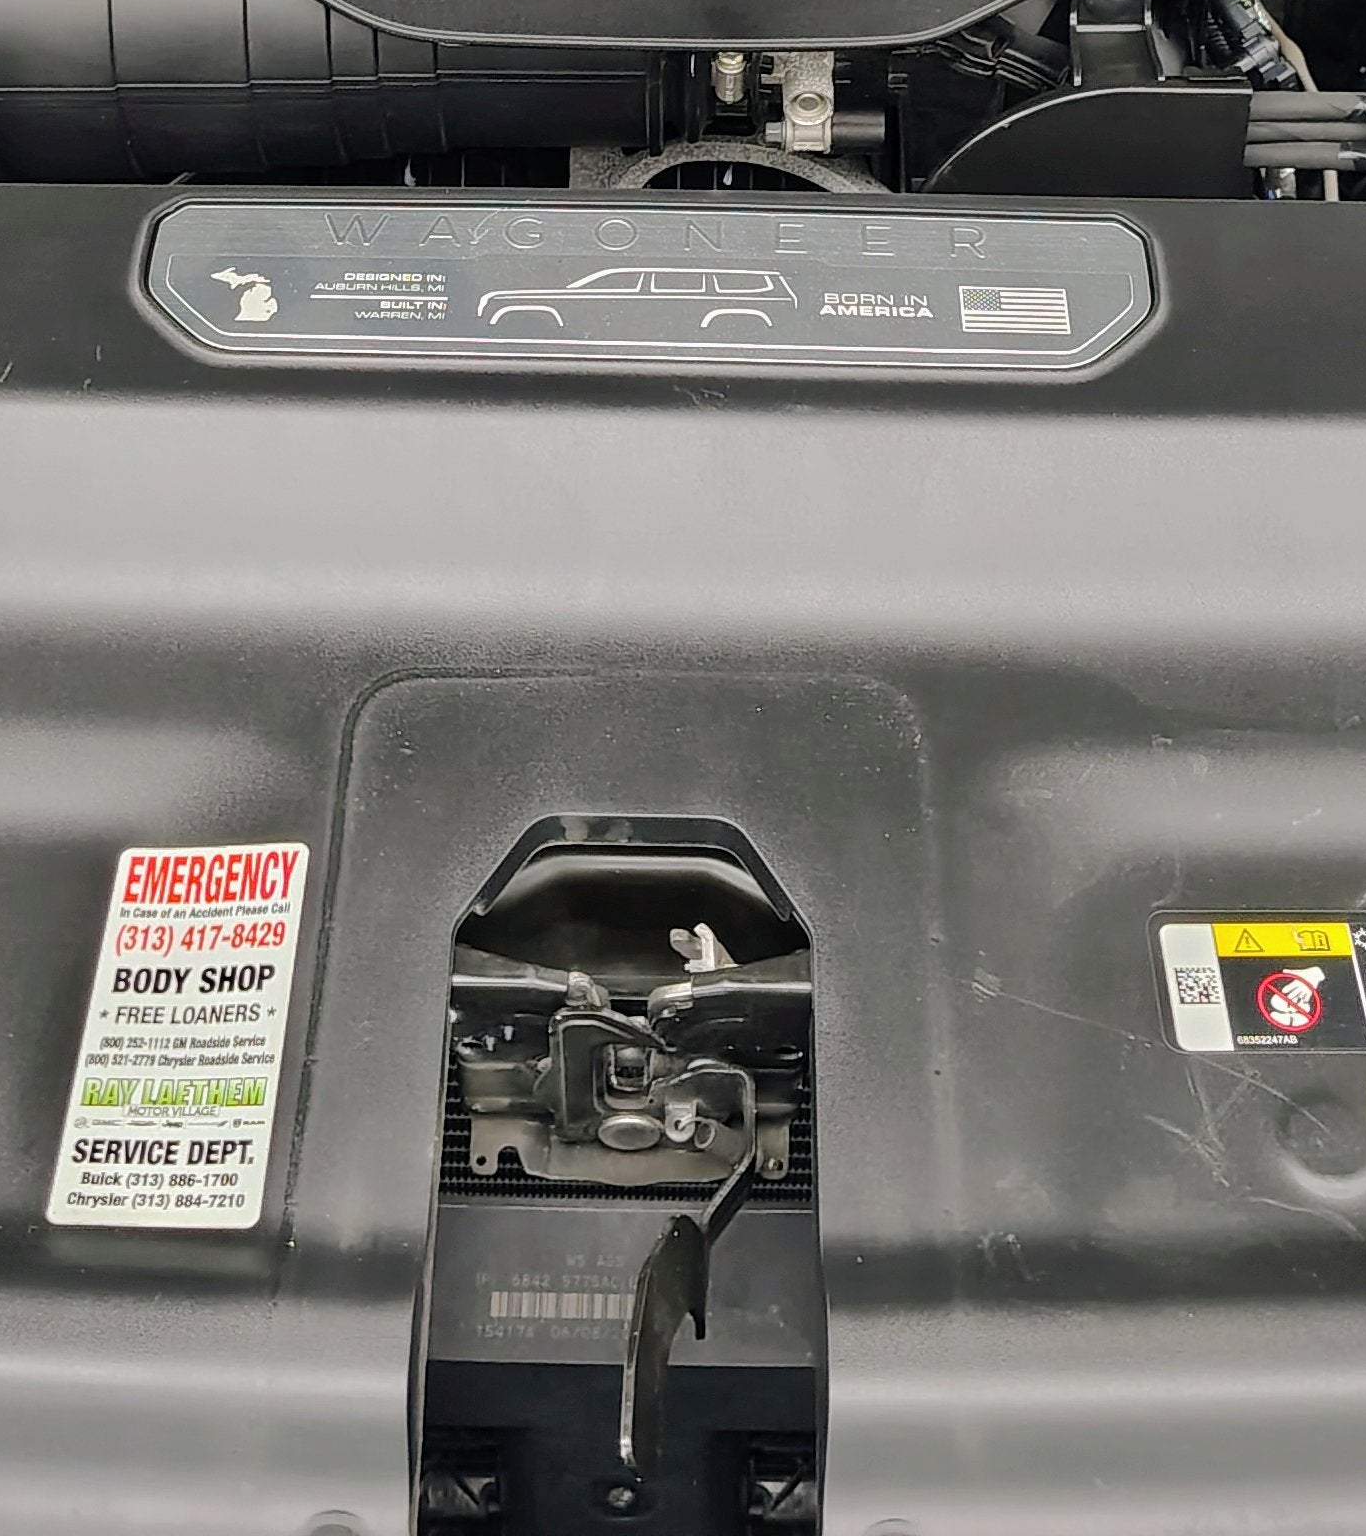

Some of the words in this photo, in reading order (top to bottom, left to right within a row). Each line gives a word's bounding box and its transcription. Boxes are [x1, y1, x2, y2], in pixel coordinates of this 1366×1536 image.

[323, 212, 987, 259] WAGONEER
[343, 272, 423, 282] DESIGNED
[314, 282, 378, 292] AUBURN
[427, 283, 445, 292] MI
[380, 300, 424, 310] BUILT
[823, 292, 894, 306] BORN
[904, 294, 928, 306] IN
[427, 312, 445, 321] MI
[819, 304, 934, 318] AMERICA
[122, 850, 300, 904] EMERGENCY
[132, 907, 159, 919] Case
[160, 906, 172, 919] of
[173, 909, 187, 919] an
[189, 906, 233, 919] Accident
[234, 904, 269, 917] Please
[270, 902, 291, 915] Call
[115, 923, 174, 957] (313)
[180, 921, 286, 951] 417-8429
[111, 967, 192, 994] BODY
[198, 964, 276, 994] SHOP
[114, 1006, 166, 1025] FREE
[169, 1004, 262, 1025] LOANERS
[188, 1035, 231, 1049] Roadside
[232, 1035, 266, 1048] Service
[157, 1053, 196, 1069] Chrysler
[198, 1052, 239, 1066] Roadside
[240, 1051, 276, 1065] Service
[80, 1077, 141, 1107] RAY
[142, 1076, 269, 1107] LAETHEM
[127, 1106, 172, 1117] MOTOR
[171, 1106, 217, 1117] VILLAGE
[71, 1138, 181, 1165] SERVICE
[186, 1138, 255, 1165] DEPT.
[79, 1172, 123, 1186] Buick
[125, 1172, 165, 1189] (313)
[168, 1172, 239, 1187] 886-1700
[66, 1192, 130, 1209] Chrysler
[131, 1192, 171, 1210] (313)
[174, 1192, 246, 1208] 884-7210
